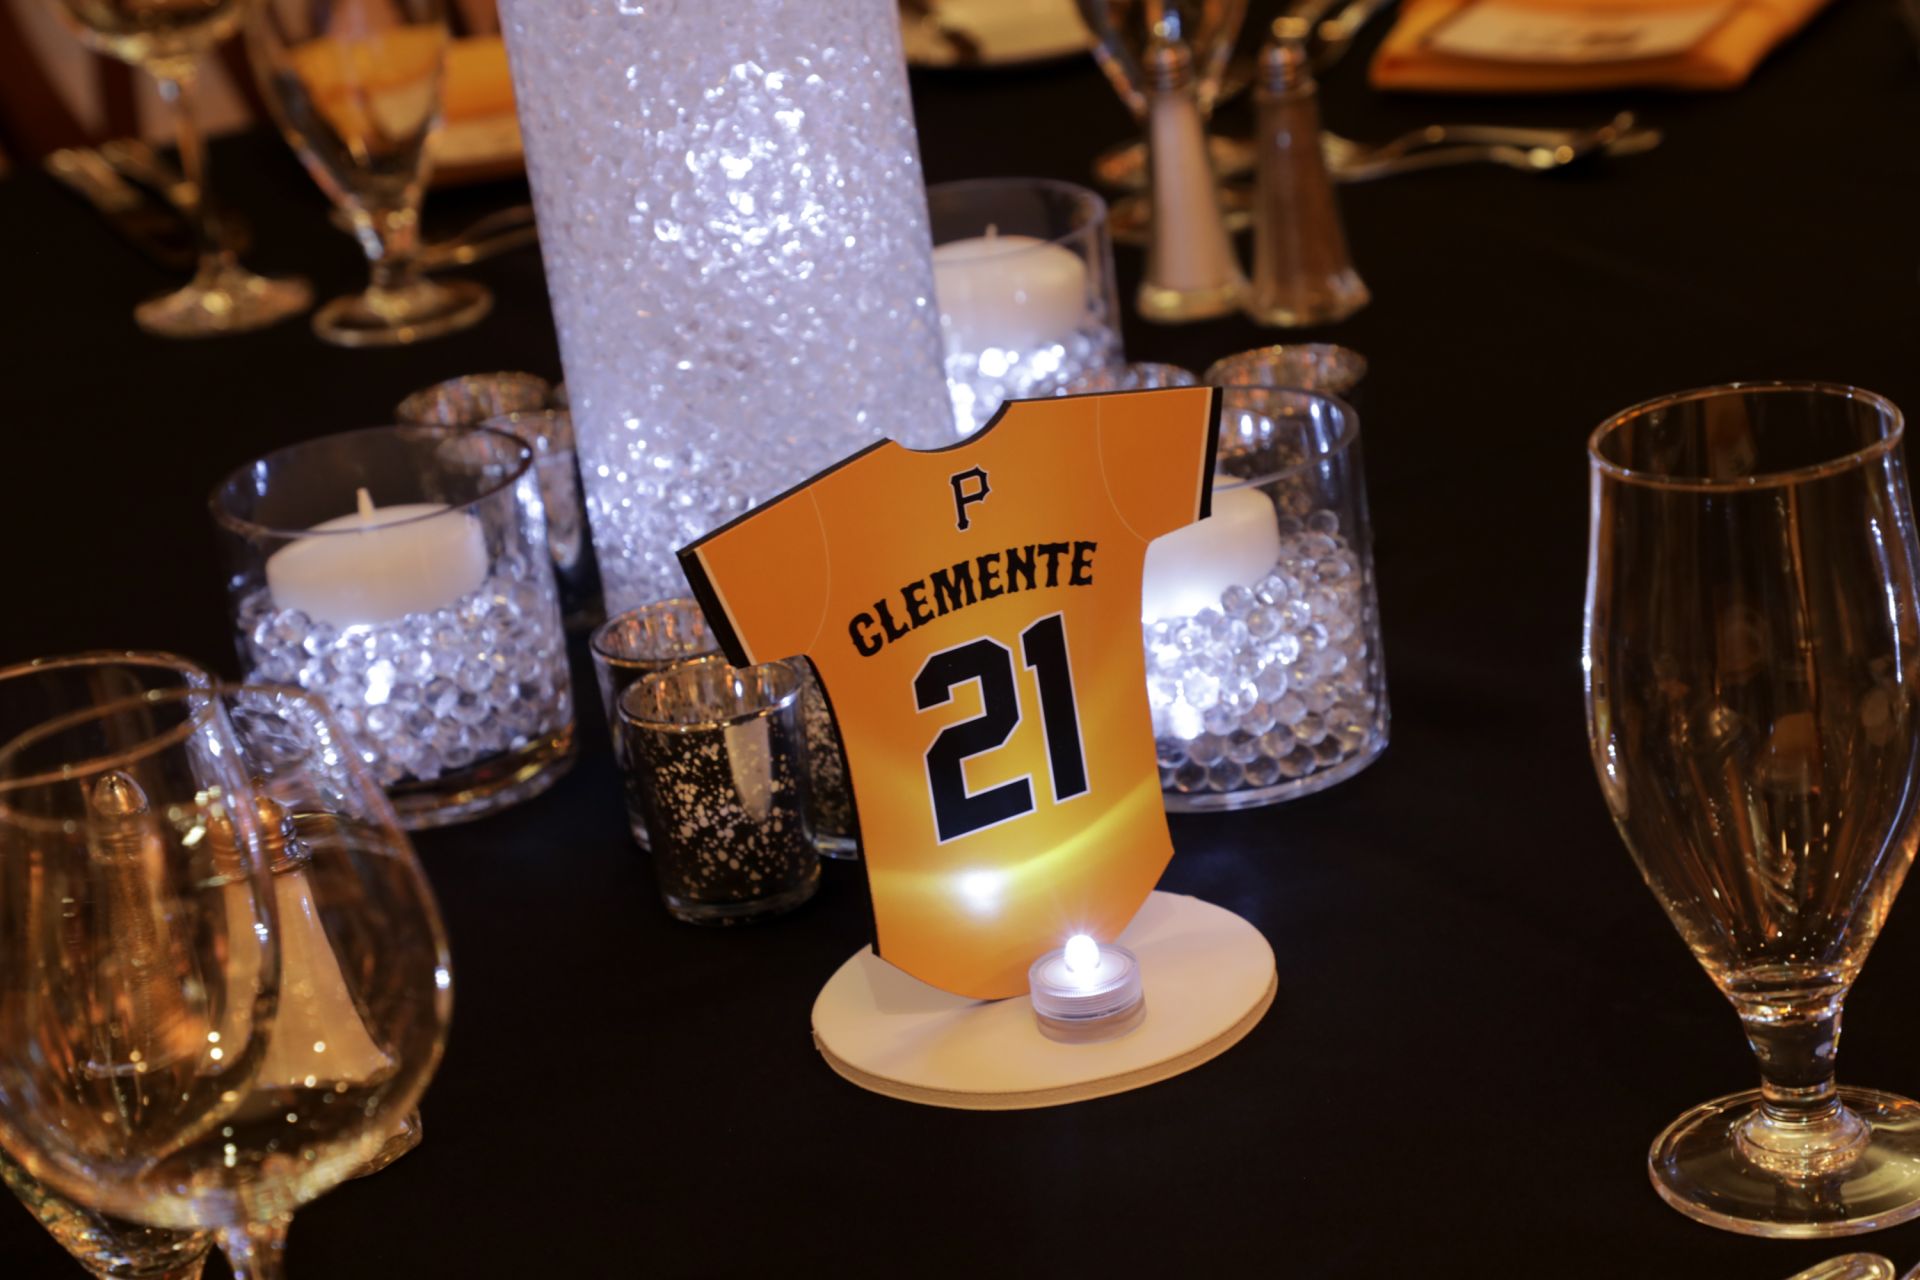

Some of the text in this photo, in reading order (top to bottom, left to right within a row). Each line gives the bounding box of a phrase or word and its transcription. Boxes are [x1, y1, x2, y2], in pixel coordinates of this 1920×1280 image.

[949, 464, 992, 532] P
[848, 541, 1098, 657] CLEMENTE
[912, 610, 1091, 846] 21
